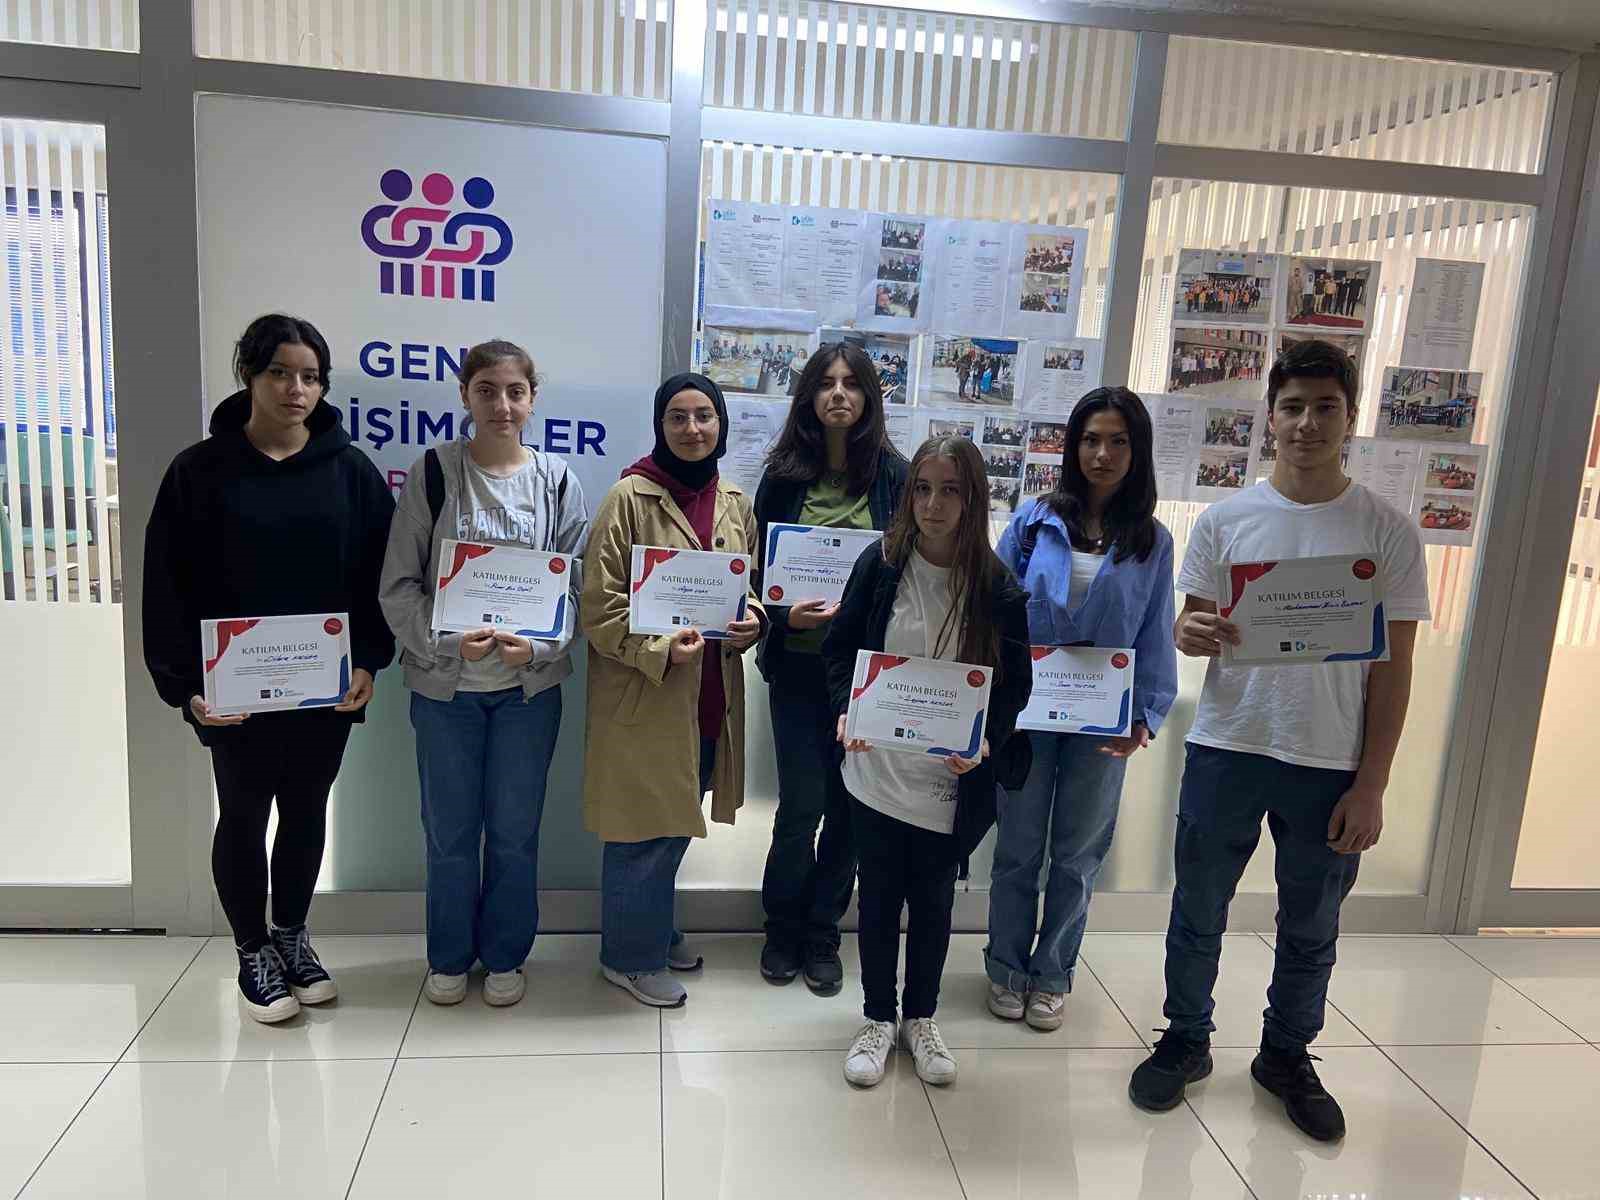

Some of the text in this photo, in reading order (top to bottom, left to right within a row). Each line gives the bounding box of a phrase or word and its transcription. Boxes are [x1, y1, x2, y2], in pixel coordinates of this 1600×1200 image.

[359, 340, 468, 381] GEN
[472, 570, 507, 583] KATILIM
[661, 575, 693, 585] KATILIM
[820, 576, 846, 585] ATILIM
[1257, 587, 1345, 603] KATILIM BELGESİ
[242, 644, 281, 656] KATILIM
[1038, 671, 1071, 681] KATILIM
[886, 681, 957, 699] KATILIM BELGESİ
